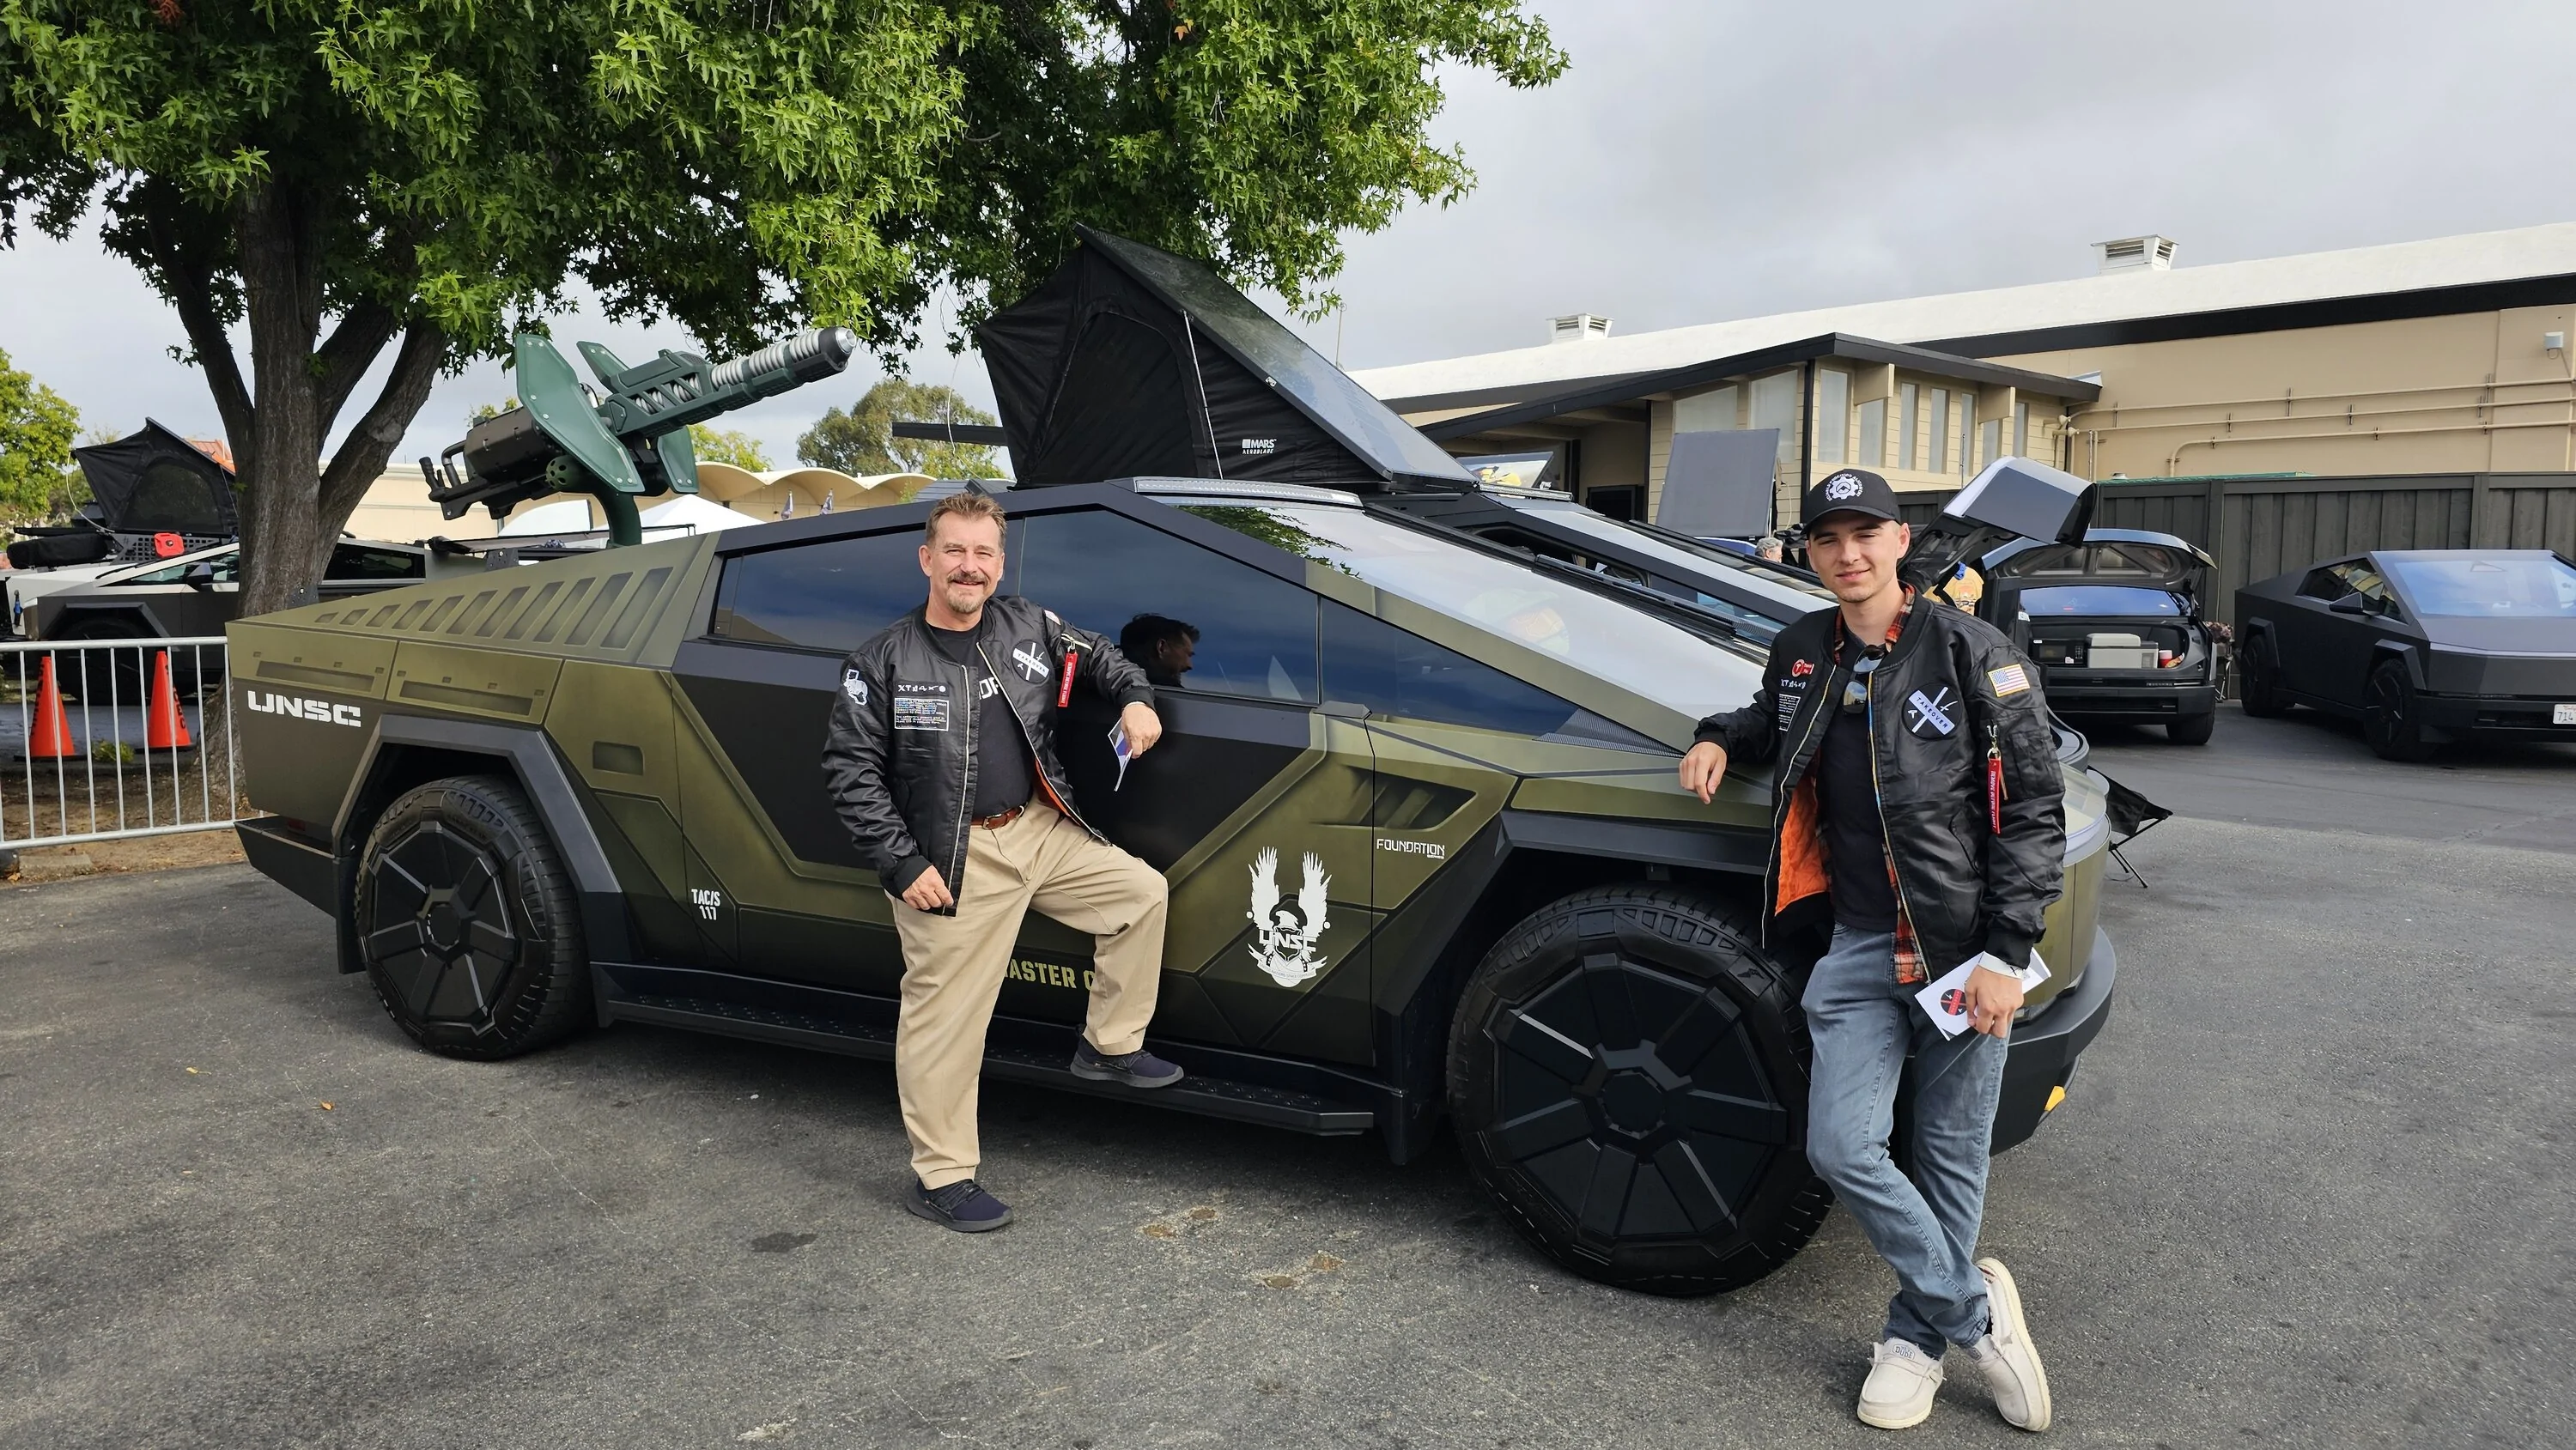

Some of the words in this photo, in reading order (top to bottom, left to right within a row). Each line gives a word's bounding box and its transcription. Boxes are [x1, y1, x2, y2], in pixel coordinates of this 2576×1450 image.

[1017, 652, 1047, 674] TAKEOVER
[247, 689, 361, 728] UNSC
[1917, 696, 1948, 729] TAKEOVER
[1376, 838, 1445, 856] FOUNDATION
[699, 905, 718, 920] 117
[1259, 929, 1317, 952] UNSC
[1005, 958, 1077, 989] ASTER
